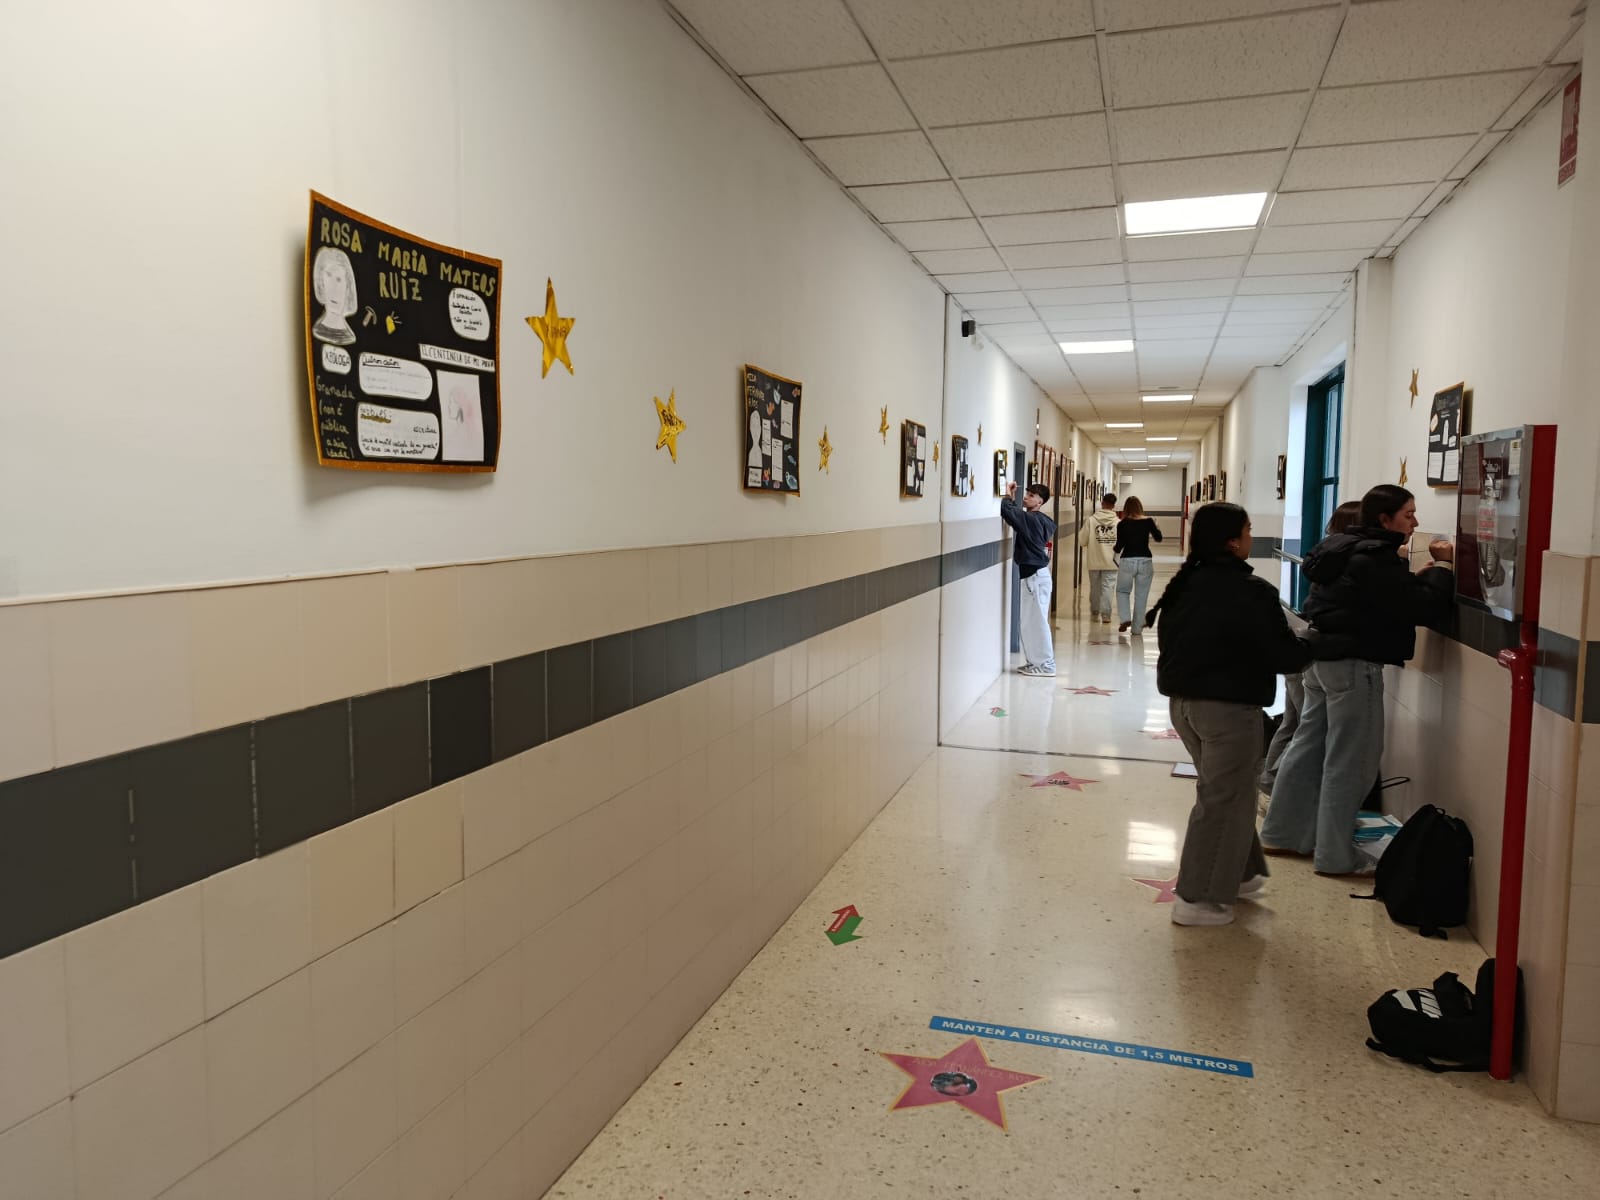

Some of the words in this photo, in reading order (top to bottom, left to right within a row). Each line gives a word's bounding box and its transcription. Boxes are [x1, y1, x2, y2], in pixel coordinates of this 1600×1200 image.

[321, 217, 362, 254] ROSA
[440, 262, 496, 296] MATEOS
[942, 1021, 1005, 1036] MANTEN
[1010, 1031, 1020, 1039] A
[1025, 1033, 1109, 1051] DISTANCIA
[1114, 1045, 1135, 1055] DE
[1141, 1050, 1164, 1060] 1,5
[1169, 1054, 1239, 1072] METROS
